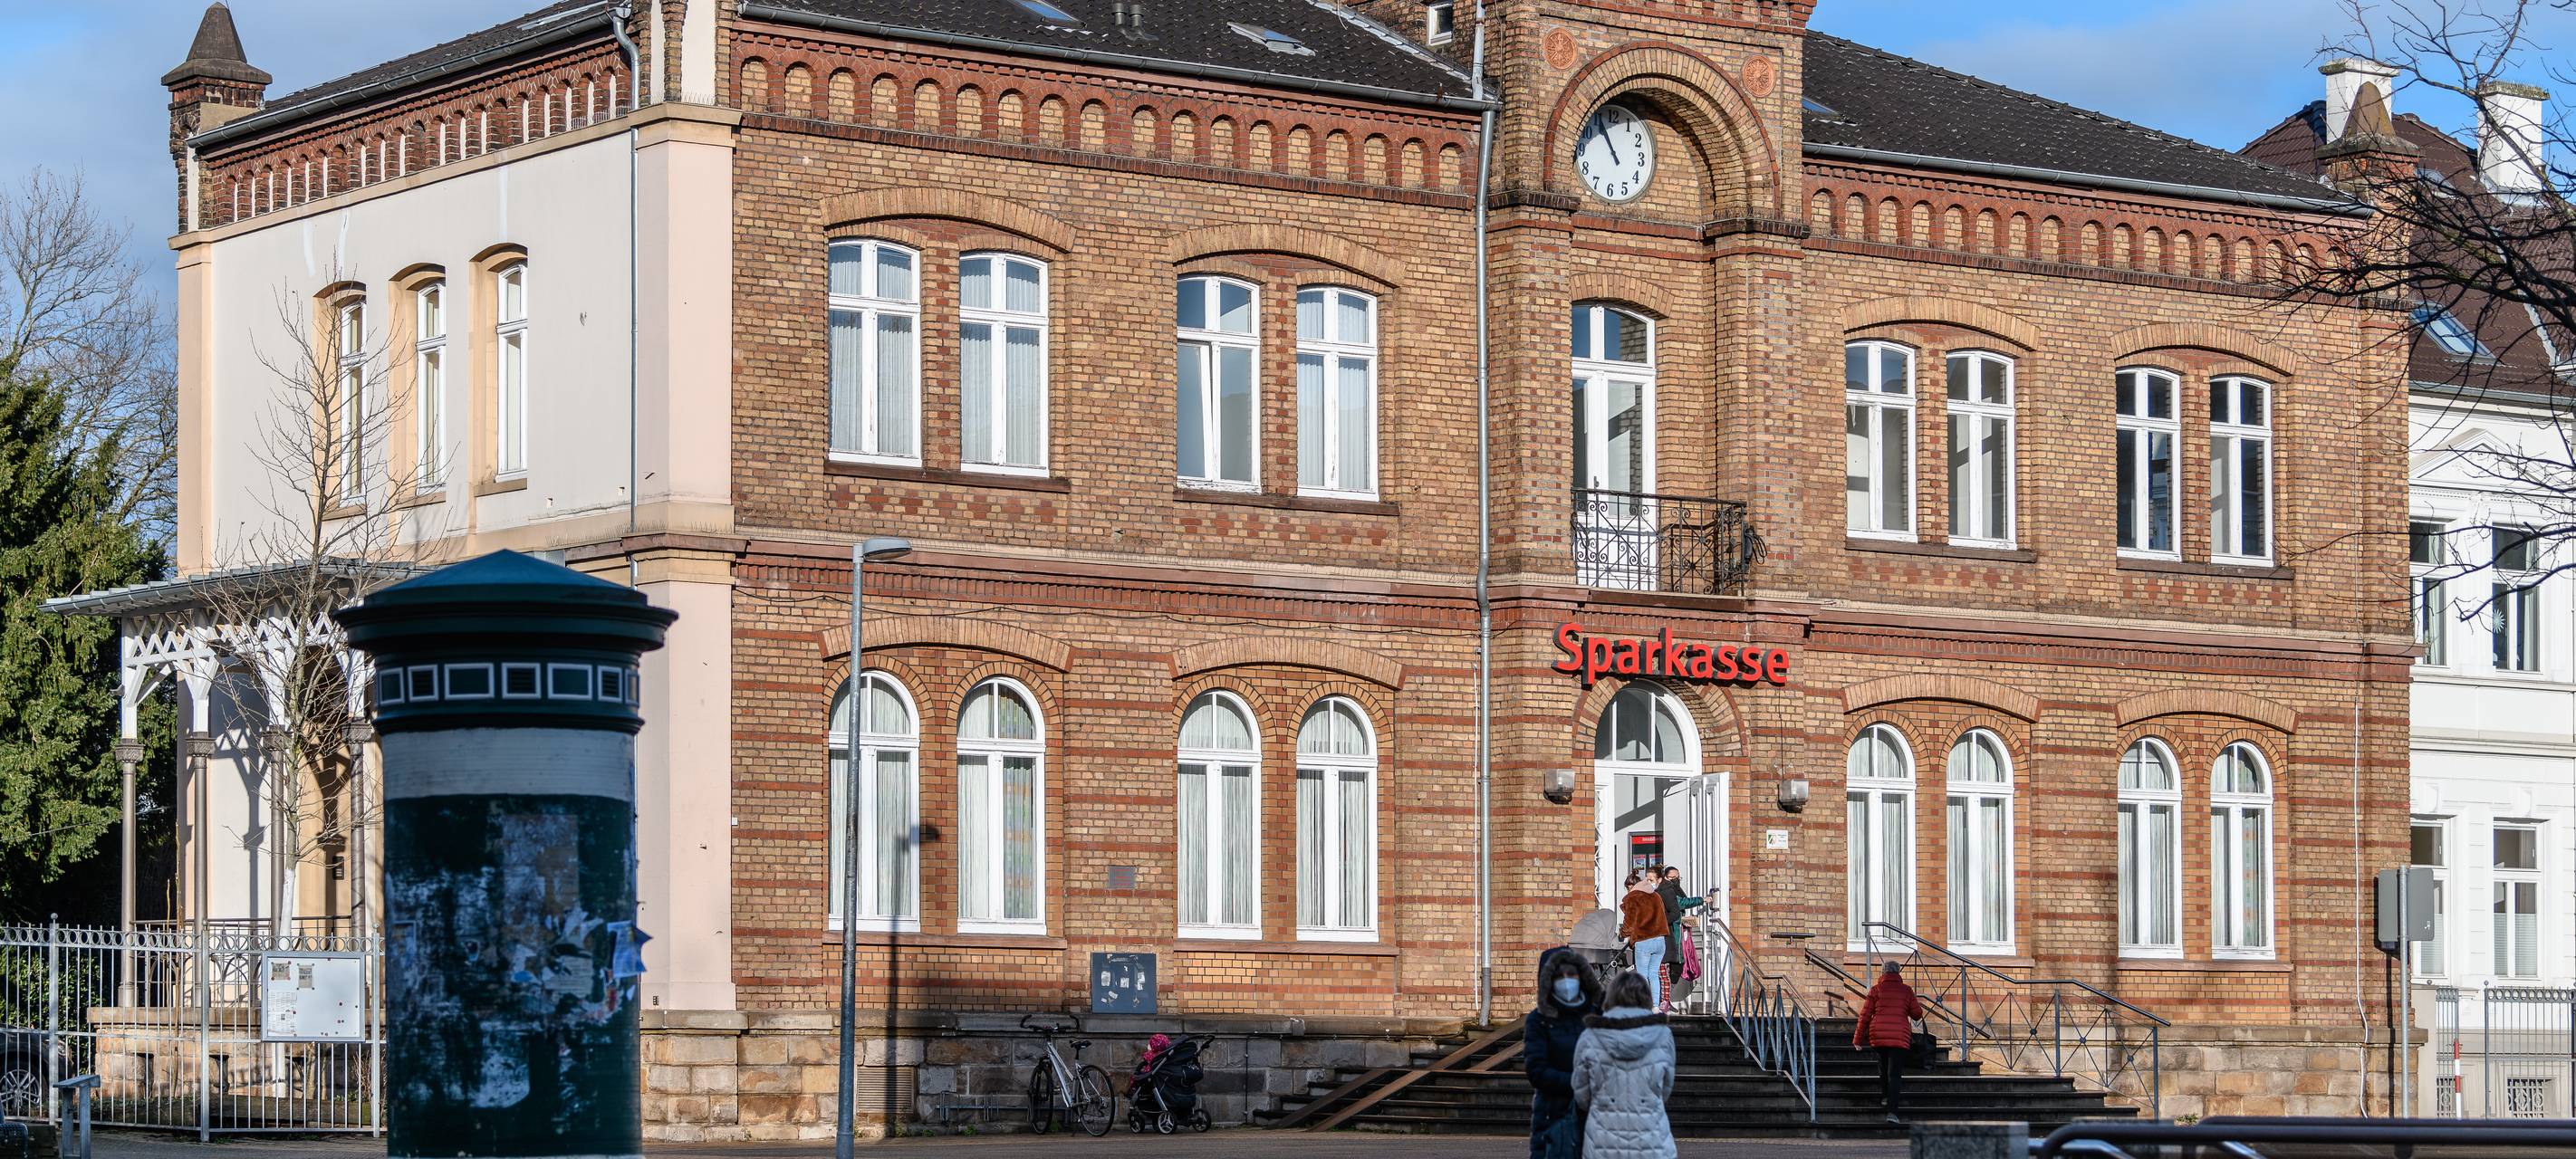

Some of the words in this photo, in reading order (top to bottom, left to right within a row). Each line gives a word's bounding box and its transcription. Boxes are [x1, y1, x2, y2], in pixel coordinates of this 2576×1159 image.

[1609, 110, 1620, 123] 12
[1581, 126, 1592, 139] 10
[1626, 119, 1630, 132] 1
[1635, 133, 1641, 148] 2
[1579, 143, 1585, 157] 9
[1638, 152, 1644, 167] 3
[1582, 161, 1589, 175] 8
[1592, 176, 1600, 190] 7
[1632, 171, 1639, 184] 4
[1607, 183, 1613, 196] 6
[1621, 182, 1628, 196] 5
[1552, 622, 1790, 685] Sparkasse
